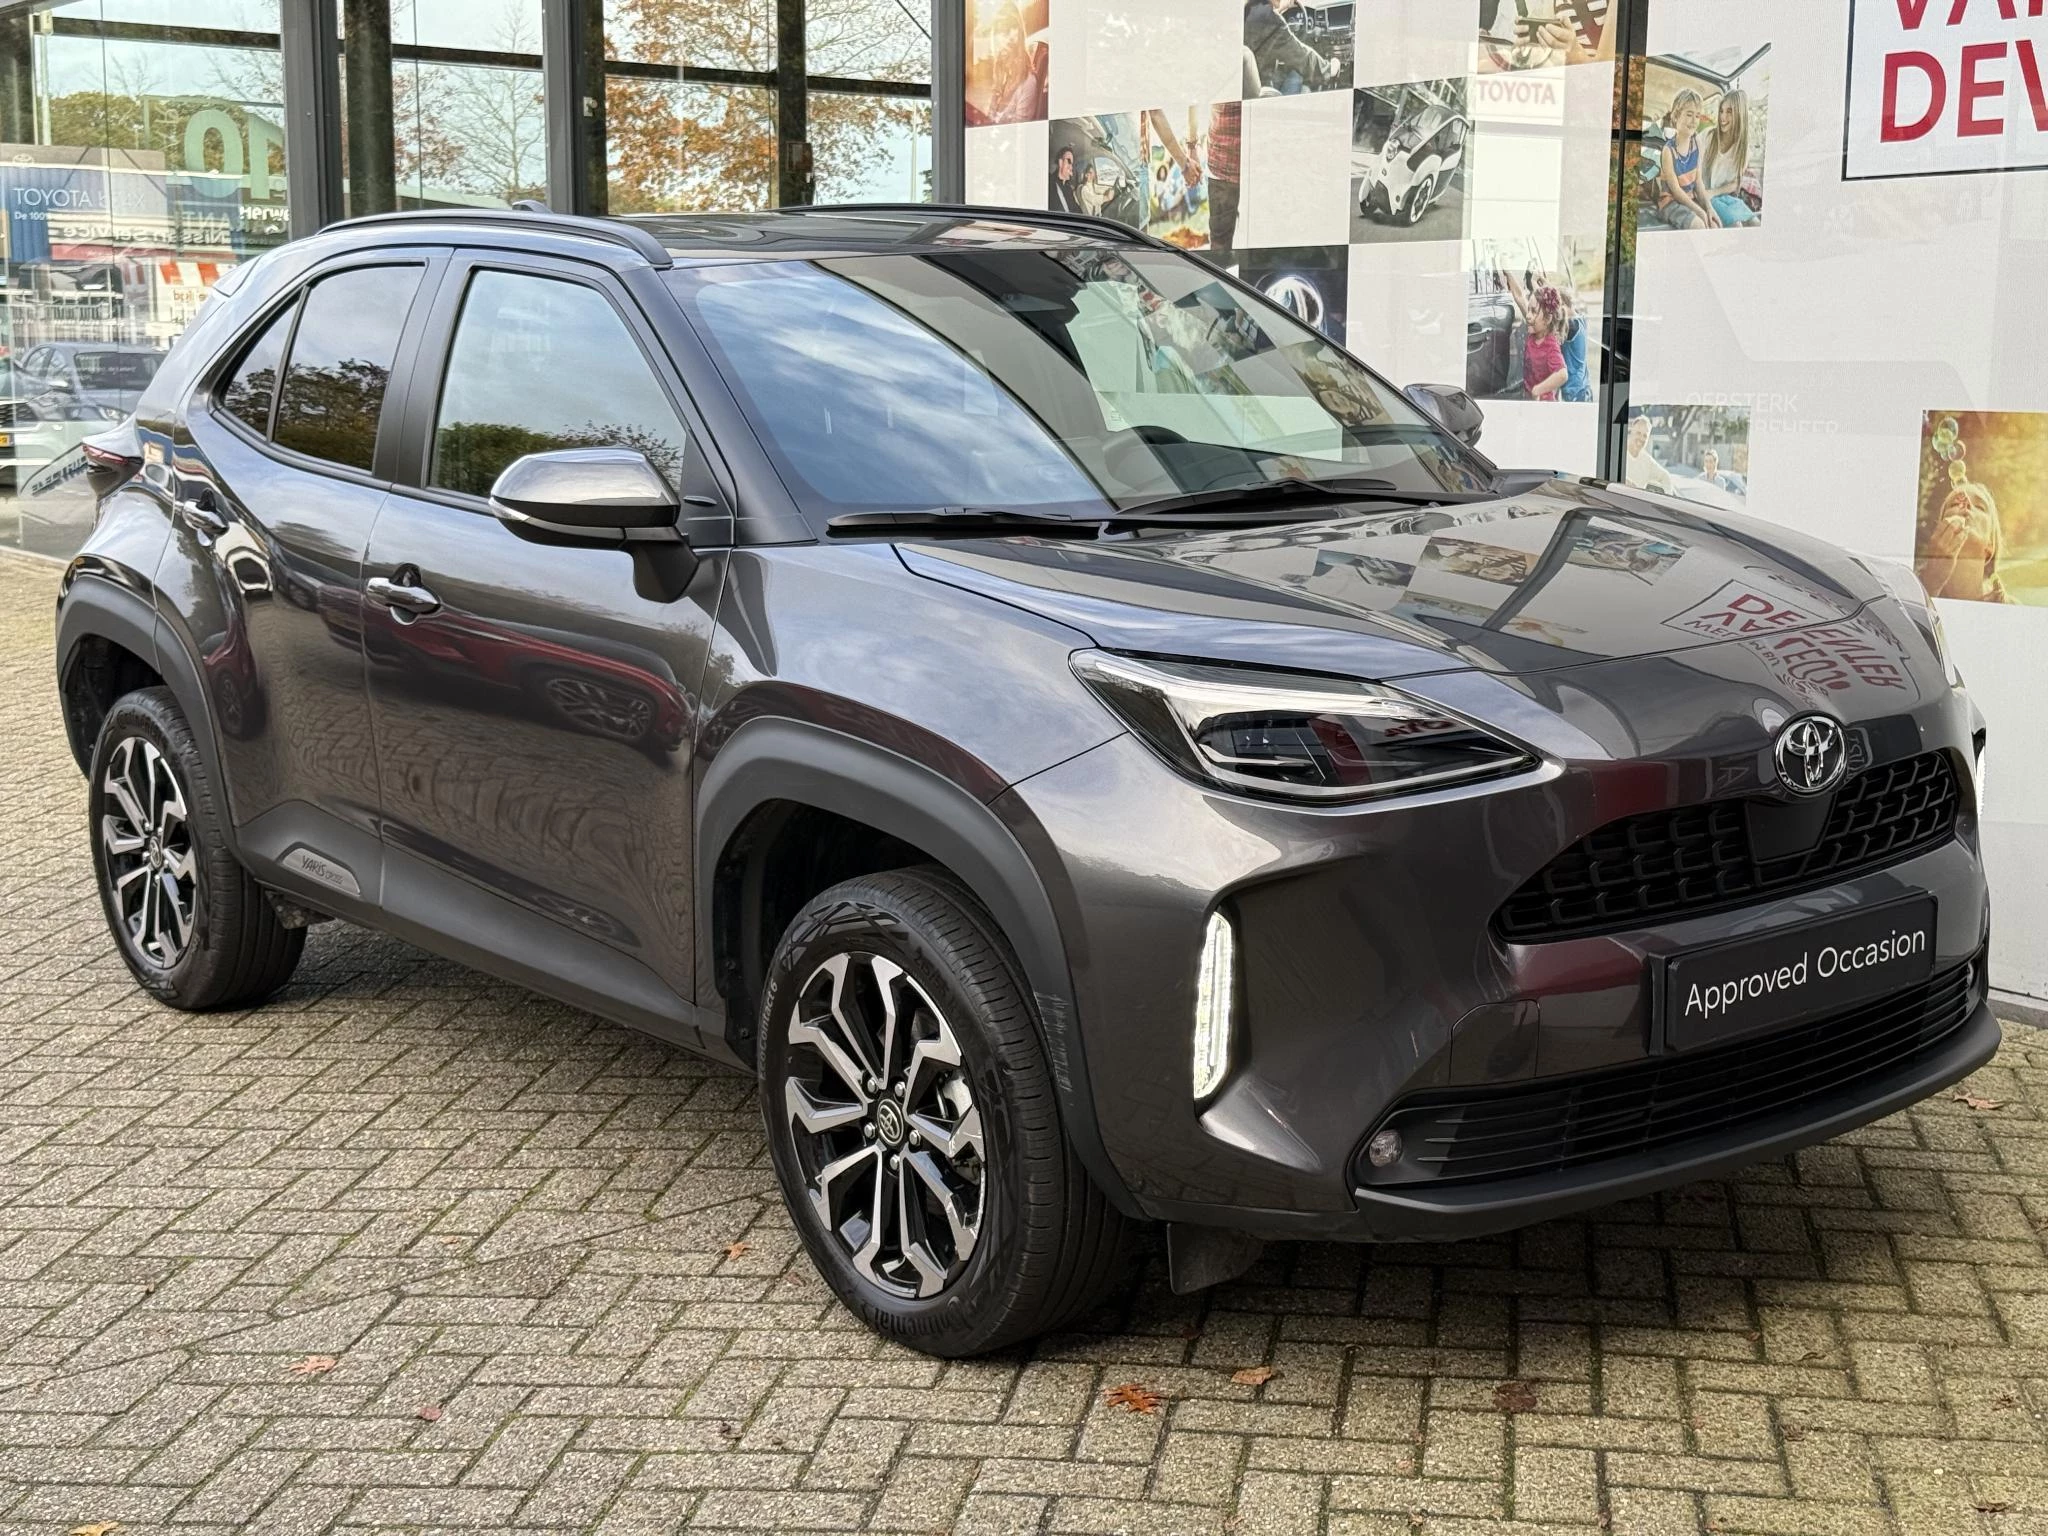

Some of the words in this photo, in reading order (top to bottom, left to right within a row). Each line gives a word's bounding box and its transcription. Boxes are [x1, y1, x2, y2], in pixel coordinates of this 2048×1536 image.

[1479, 79, 1556, 105] TOYOTA
[13, 187, 94, 207] TOYOTA
[1684, 952, 1808, 1019] Approved
[1817, 930, 1926, 978] Occasion
